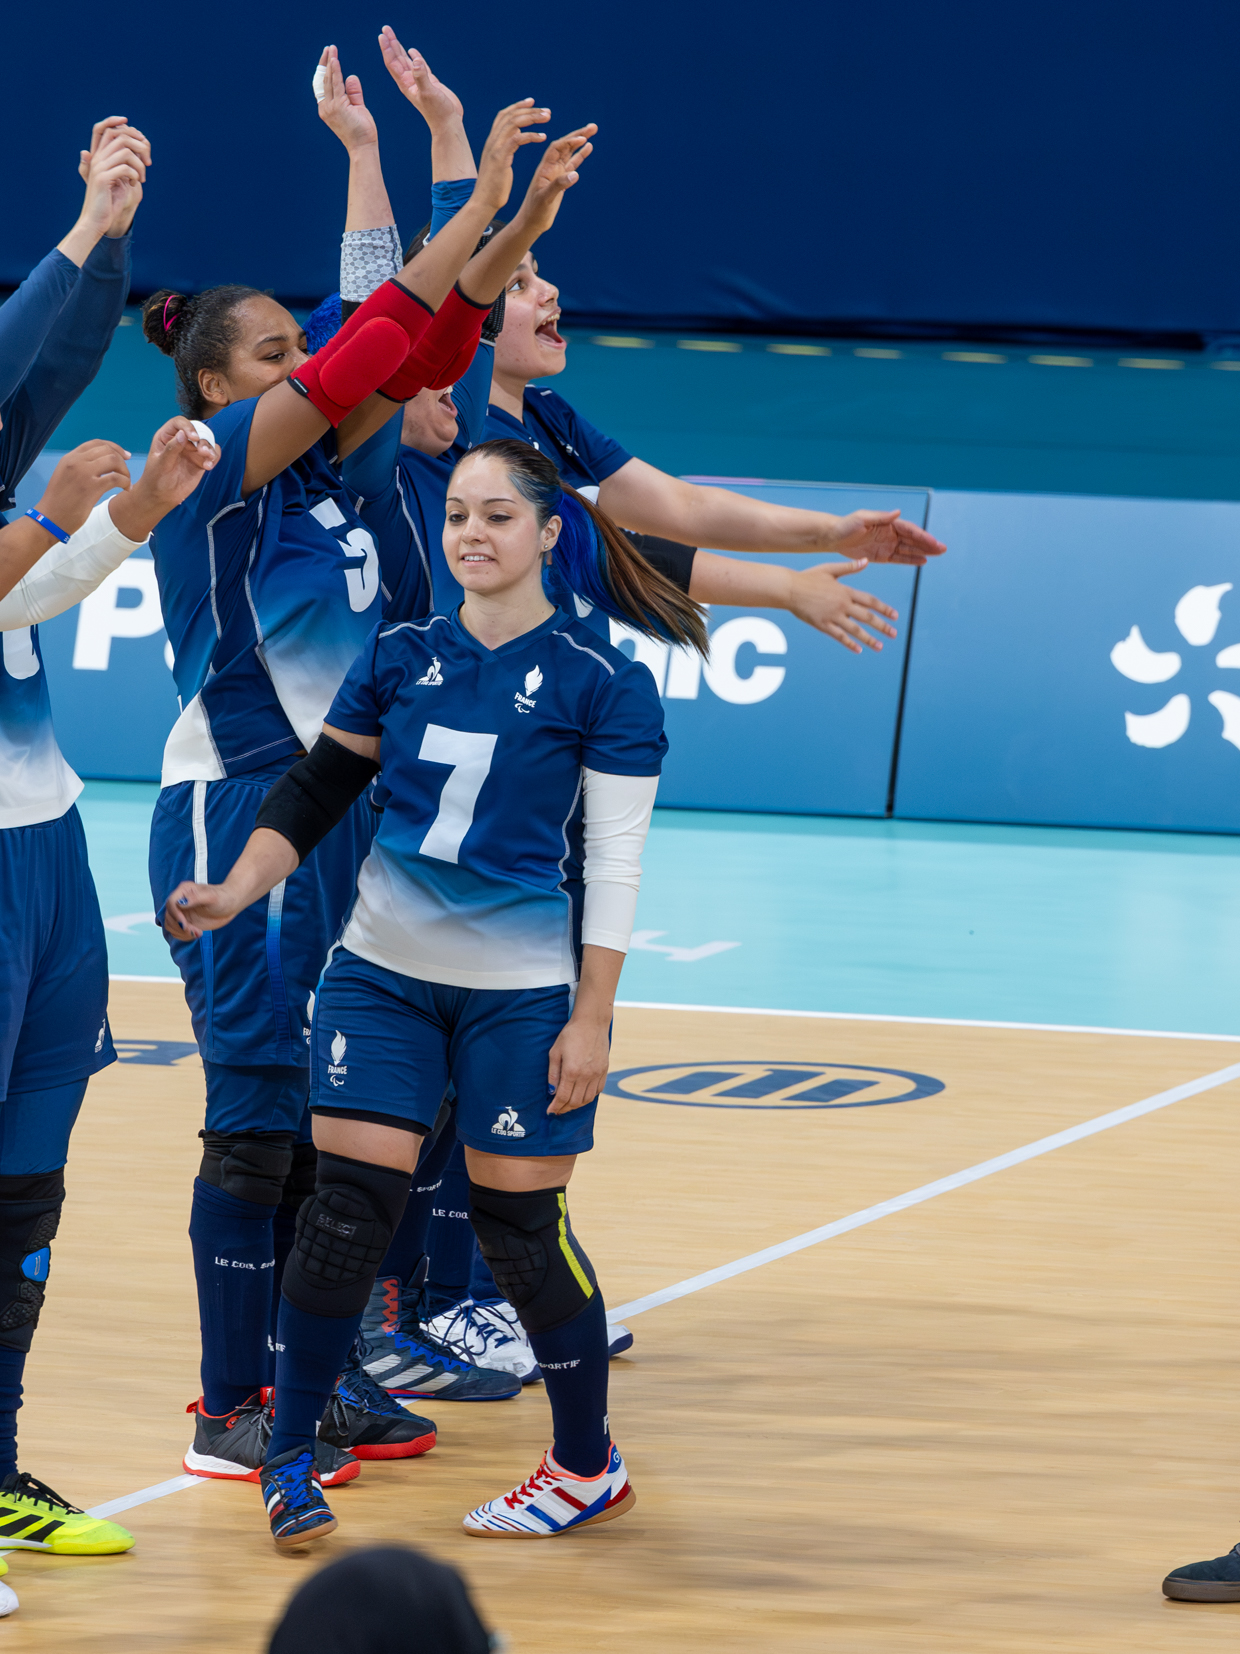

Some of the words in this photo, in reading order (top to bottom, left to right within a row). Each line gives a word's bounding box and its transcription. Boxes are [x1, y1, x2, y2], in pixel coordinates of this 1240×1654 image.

[514, 691, 537, 708] FRANCE
[418, 723, 498, 864] 7
[327, 1064, 348, 1075] FRANCE
[432, 1208, 446, 1217] LE
[448, 1210, 469, 1220] COQ
[215, 1256, 229, 1267] LE
